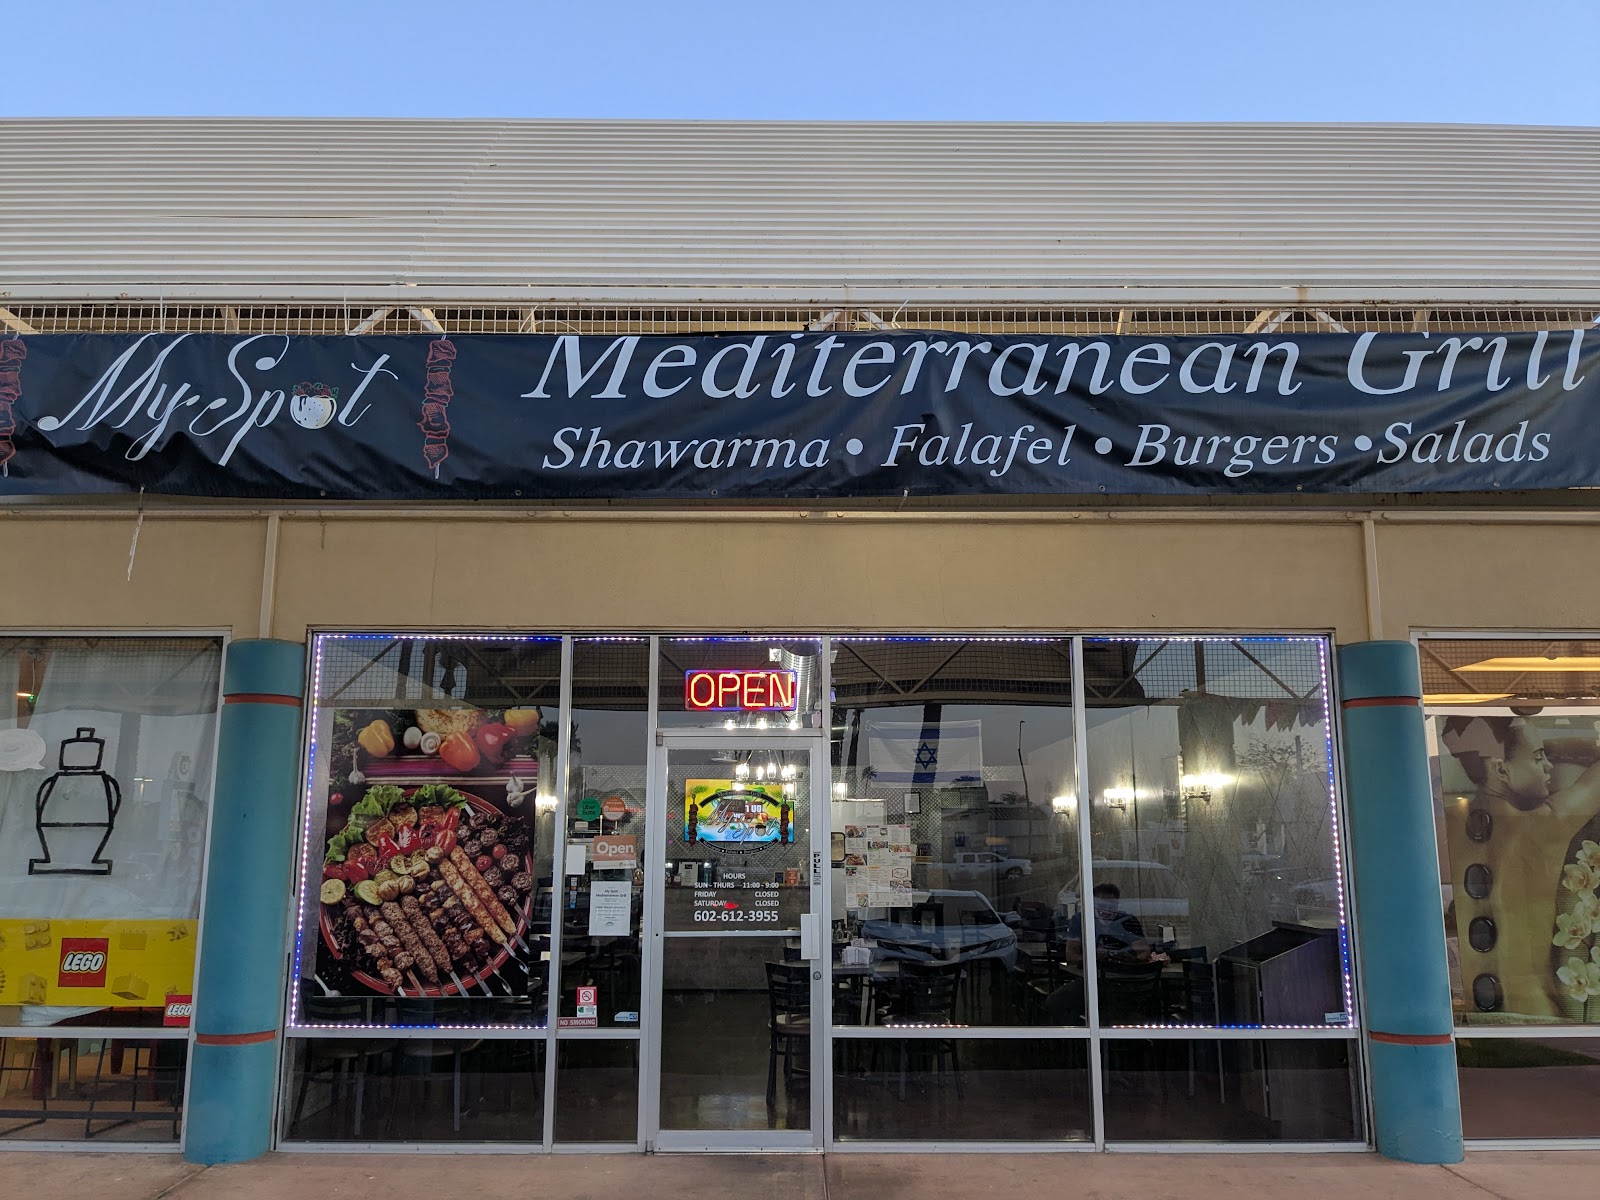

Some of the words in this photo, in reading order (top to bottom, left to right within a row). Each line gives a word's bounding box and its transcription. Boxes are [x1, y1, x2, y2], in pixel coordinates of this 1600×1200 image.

[521, 332, 1303, 399] Mediterranean
[1347, 329, 1588, 396] Grill
[37, 332, 201, 461] My
[542, 425, 830, 469] Shawarma
[880, 423, 1076, 477] Falafel
[1124, 423, 1339, 478] Burgers
[1376, 420, 1552, 465] Salads
[690, 673, 793, 708] OPEN
[596, 841, 635, 857] Open
[813, 853, 821, 874] PULL
[723, 872, 746, 880] HOURS
[694, 881, 708, 889] SUN
[713, 881, 735, 889] THURS
[742, 881, 760, 889] 11:00
[765, 881, 779, 889] 9:00
[693, 899, 727, 907] SATURDAY
[693, 910, 779, 922] 602-612-3955
[63, 952, 105, 973] LEGO
[166, 1003, 192, 1016] LEGO
[569, 1018, 596, 1026] SMOKING
